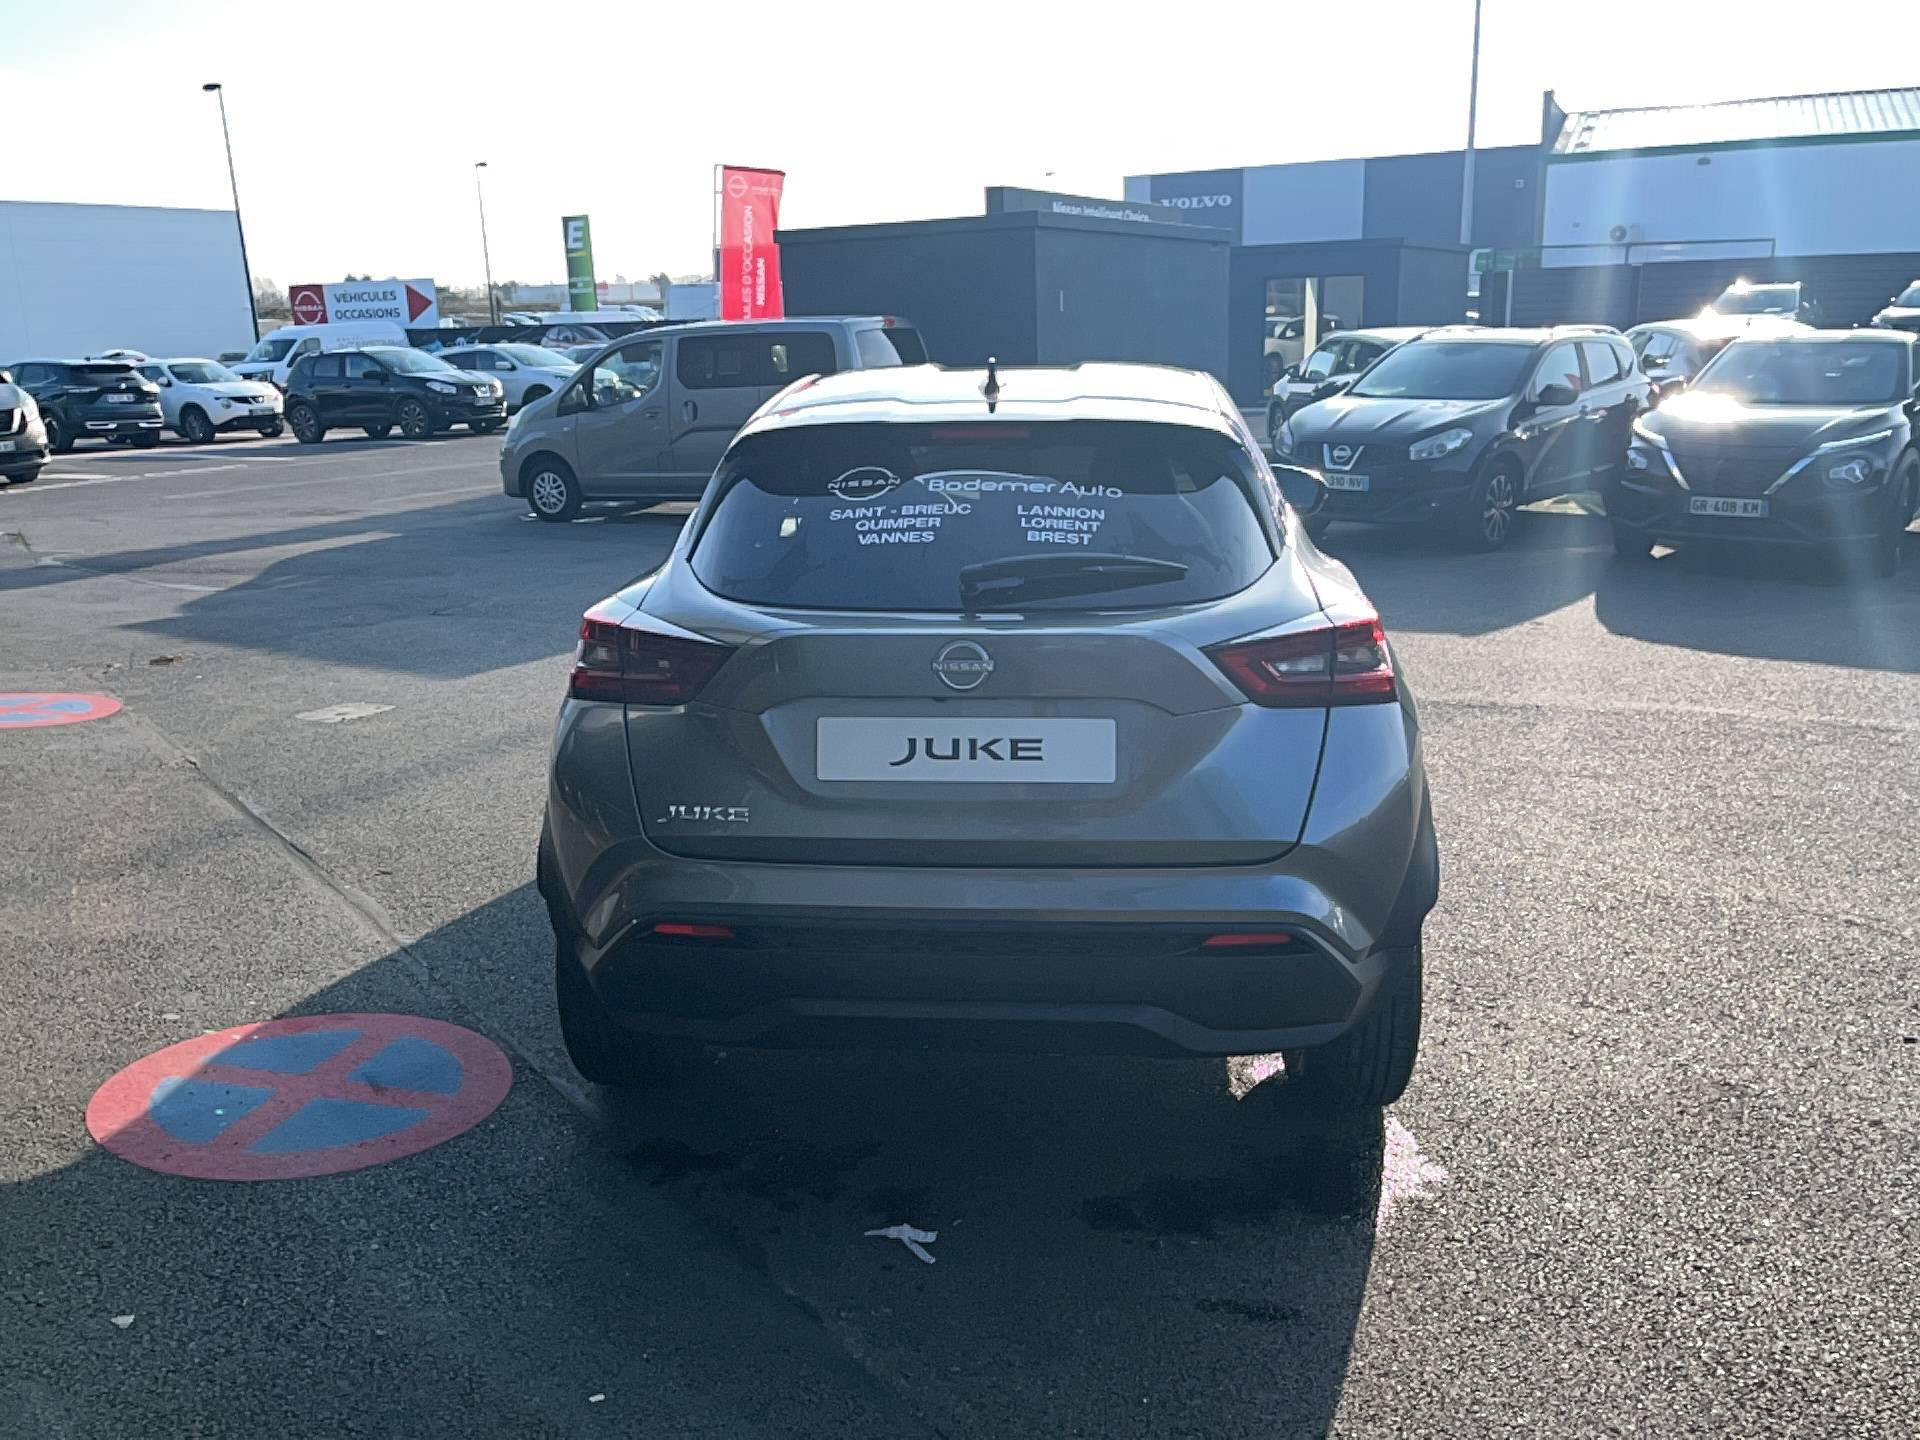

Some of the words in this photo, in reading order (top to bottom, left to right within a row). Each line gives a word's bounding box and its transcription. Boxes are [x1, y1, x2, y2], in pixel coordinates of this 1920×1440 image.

[1161, 194, 1233, 209] VOLVO
[755, 256, 766, 306] NISSAN
[334, 307, 401, 321] OCCASIONS
[827, 475, 901, 490] NISSAN
[1059, 481, 1123, 499] Auto
[829, 506, 887, 521] SAINT
[1017, 504, 1105, 520] LANNION
[855, 517, 942, 531] QUIMPER
[1020, 517, 1100, 532] LORIENT
[857, 531, 935, 545] VANNES
[1026, 531, 1093, 545] BREST
[932, 660, 995, 672] NISSAN
[888, 737, 1044, 767] JUKE
[656, 805, 749, 823] JUKE
